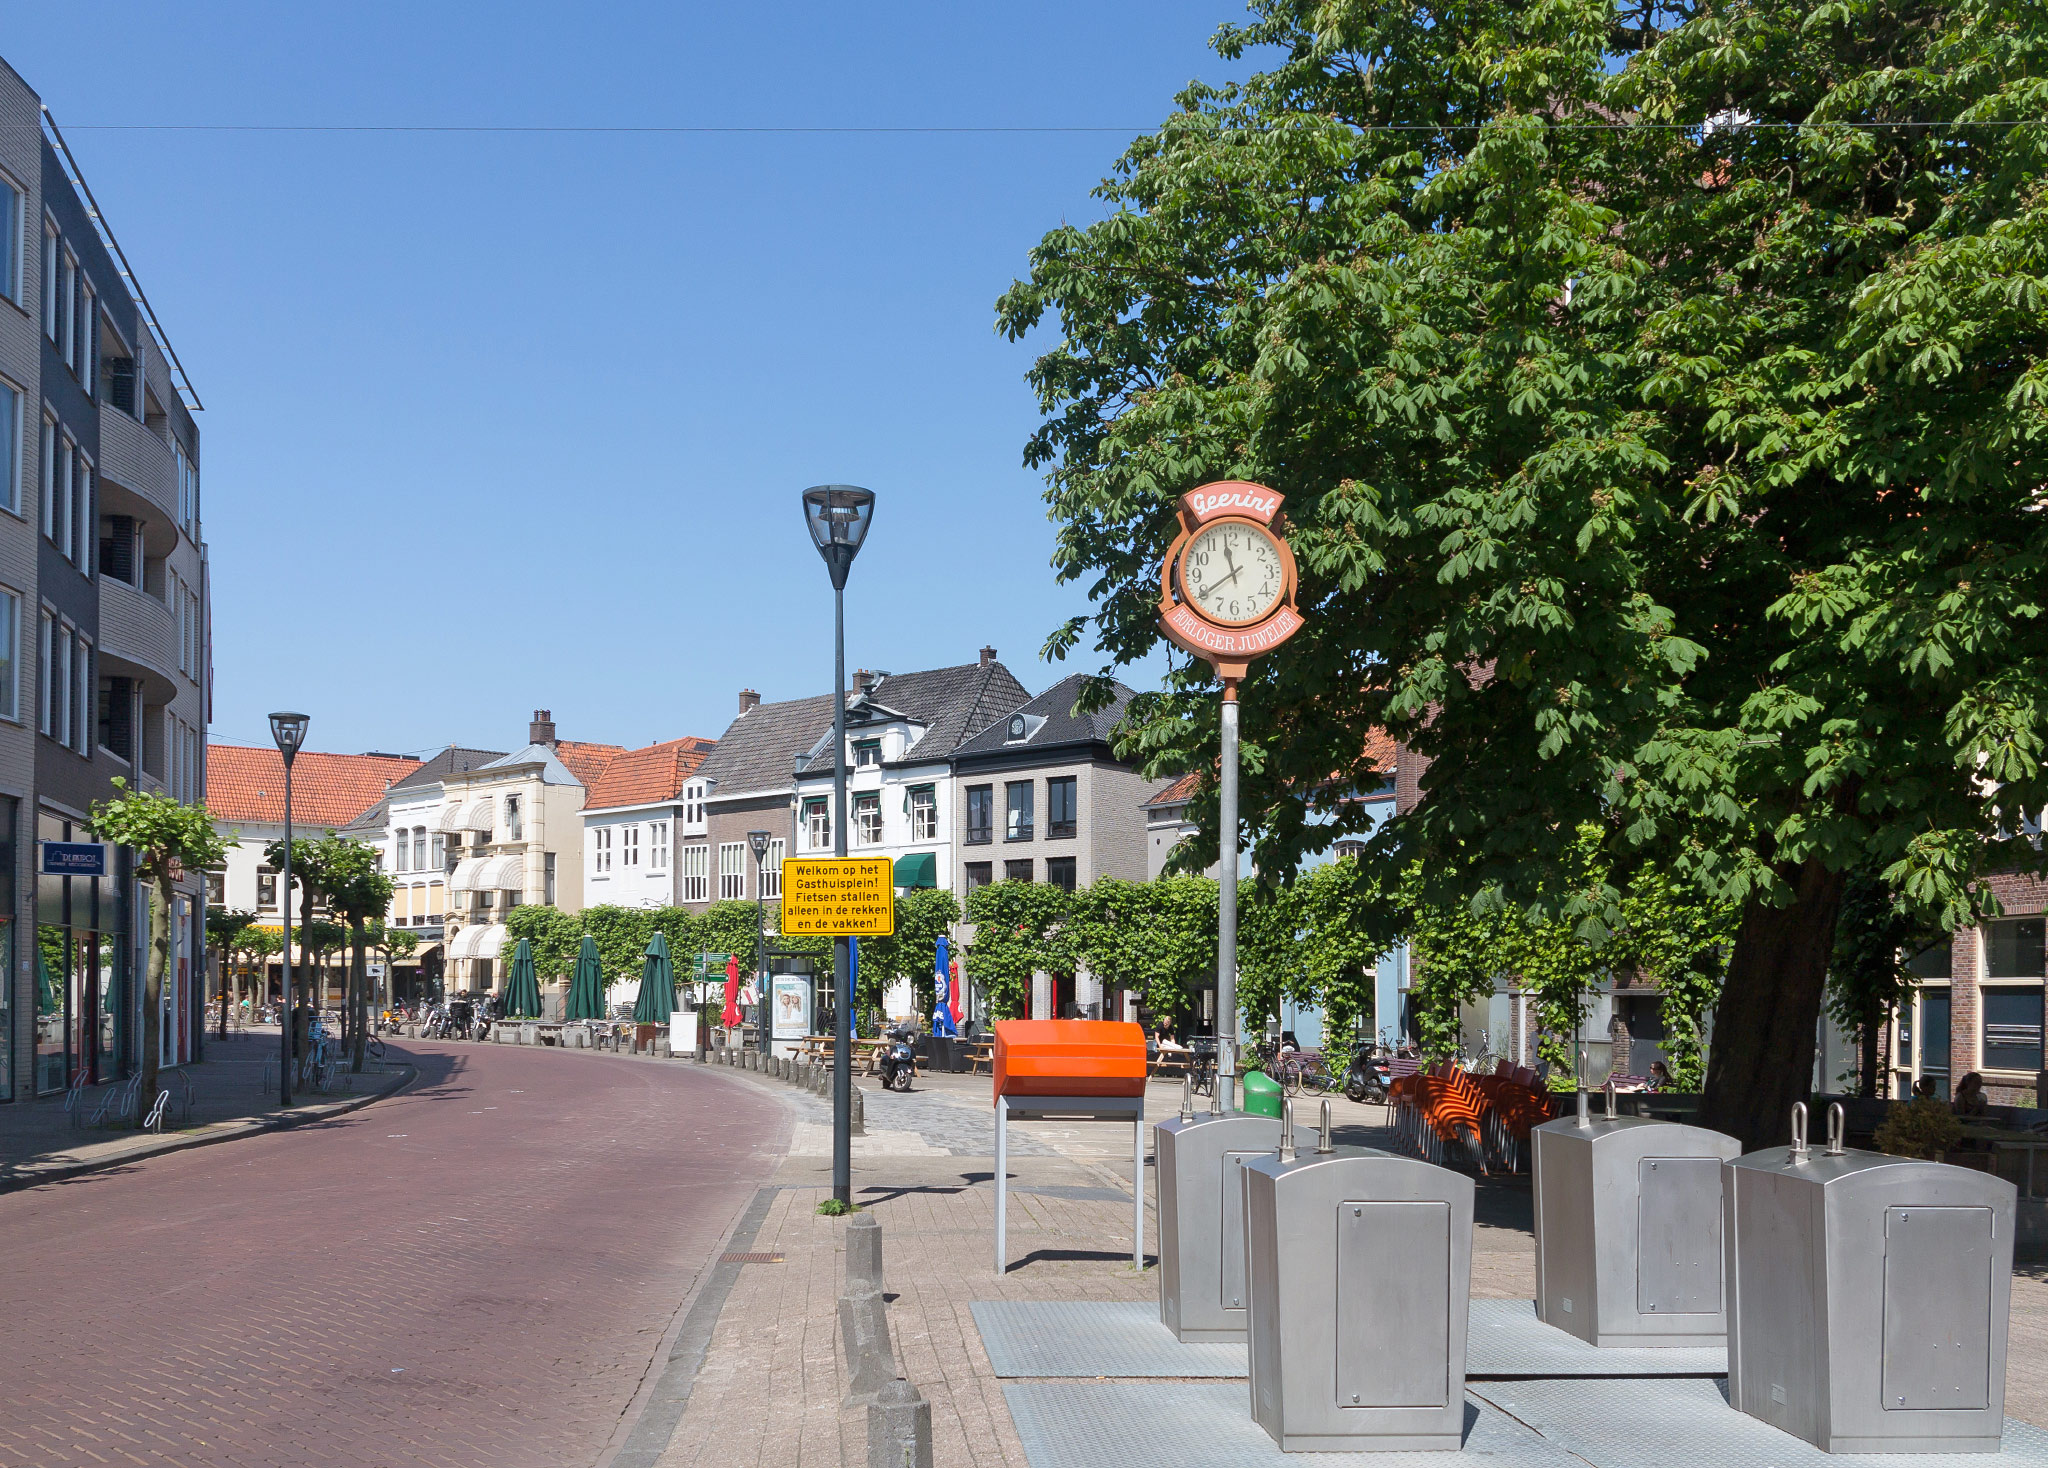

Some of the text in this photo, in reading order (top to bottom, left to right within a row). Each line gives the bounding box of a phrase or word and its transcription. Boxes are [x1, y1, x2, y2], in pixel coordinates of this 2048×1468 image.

[1193, 489, 1275, 516] Geerink
[1207, 538, 1216, 552] 11
[1247, 537, 1251, 551] 1
[1195, 551, 1209, 566] 10
[1256, 547, 1267, 562] 2
[1192, 567, 1202, 583] 9
[1264, 564, 1275, 580] 3
[1199, 584, 1209, 600] 8
[1257, 581, 1272, 597] 4
[1215, 596, 1225, 612] 7
[1229, 600, 1240, 616] 6
[1246, 595, 1256, 612] 5
[1172, 608, 1296, 651] HORLOGER JUWELIER
[796, 864, 879, 876] Welkom op het
[796, 877, 878, 890] Gasthuisplein!
[796, 891, 880, 902] Fietsen stallen
[787, 904, 888, 916] alleen in de rekken
[797, 917, 877, 929] en de vakken!
